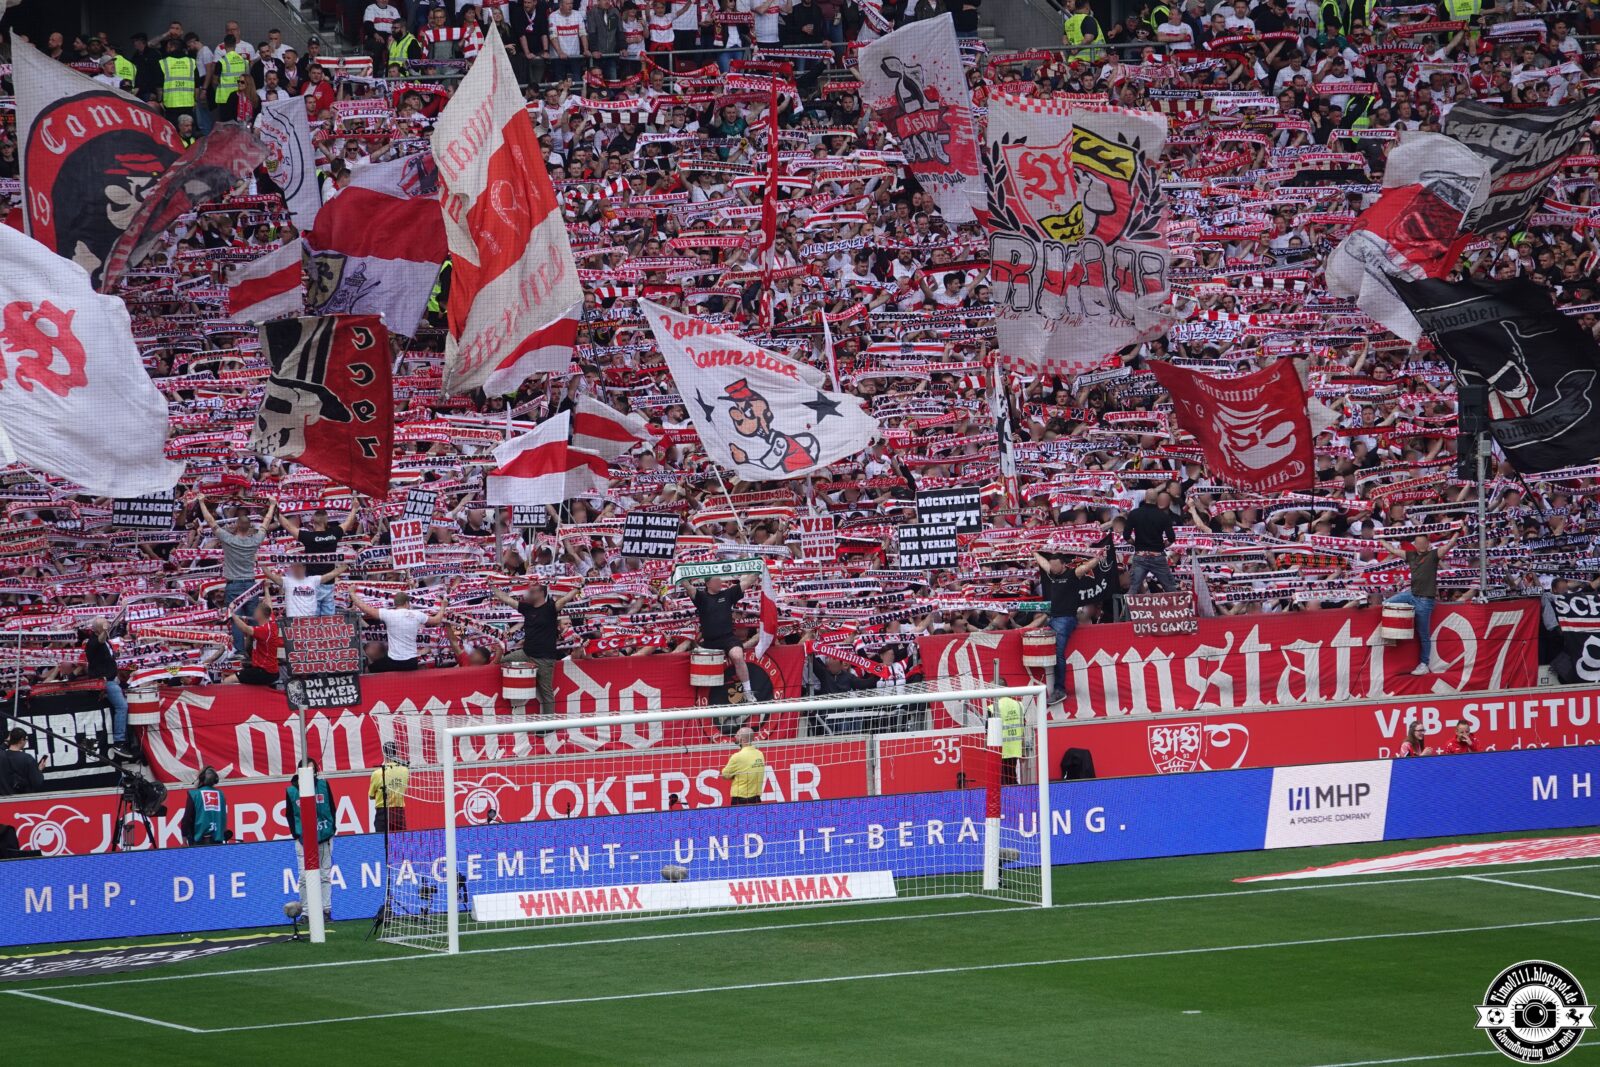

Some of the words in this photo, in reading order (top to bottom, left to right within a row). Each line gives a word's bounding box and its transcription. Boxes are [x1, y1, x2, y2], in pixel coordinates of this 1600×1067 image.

[581, 98, 639, 109] STUTTGART
[409, 490, 437, 502] VOGT
[918, 494, 980, 507] RÜCKTRITT
[114, 501, 128, 512] DU
[130, 501, 173, 512] FALSCHE
[405, 501, 434, 513] UND
[513, 505, 546, 513] ADRION
[112, 514, 172, 526] SCHLANGE
[513, 513, 546, 524] RAUS
[627, 515, 646, 526] IHR
[649, 515, 678, 527] MACHT
[802, 517, 834, 532] VfB
[391, 521, 422, 539] VfB
[624, 529, 642, 539] DEN
[644, 530, 676, 540] VEREIN
[900, 528, 917, 538] IHR
[920, 526, 955, 537] MACHT
[1383, 522, 1450, 535] COMMANDO
[392, 536, 423, 545] STUTTGART
[900, 541, 918, 551] DEN
[922, 539, 956, 549] VEREIN
[408, 543, 424, 552] SIND
[622, 542, 675, 556] KAPUTT
[803, 546, 836, 558] WIR
[270, 553, 345, 563] COMMANDO
[393, 551, 425, 566] WIR
[900, 552, 957, 567] KAPUTT
[680, 565, 719, 577] MAGIC
[734, 560, 763, 573] FANS
[1370, 573, 1389, 583] CC
[826, 593, 904, 608] COMMANDO
[1126, 594, 1168, 607] ULTRA
[1226, 589, 1296, 601] COMMANDO
[291, 615, 345, 627] JEDER
[868, 604, 933, 625] COMMANDO
[1130, 610, 1153, 620] DER
[284, 624, 354, 640] VERBANNTE
[1133, 623, 1158, 633] UMS
[1160, 620, 1199, 633] GANZE
[293, 638, 350, 649] KEHRT
[597, 638, 620, 649] CC
[641, 635, 661, 644] 97
[287, 647, 360, 663] STÄRKER
[812, 640, 872, 669] Commando
[1429, 609, 1524, 694] 97
[291, 661, 360, 674] ZURÜCK
[305, 678, 323, 689] DU
[328, 675, 354, 685] BIST
[306, 684, 357, 698] IMMER
[309, 697, 327, 707] BEI
[332, 694, 359, 706] UNS!
[1375, 696, 1600, 738] VfB-STIFTU
[1151, 725, 1200, 755] VfB
[933, 738, 961, 765] 35
[520, 763, 821, 821] JOKERSAR
[1315, 782, 1370, 808] MHP
[1290, 817, 1296, 825] A
[1297, 815, 1333, 825] PORSCHE
[1335, 811, 1371, 822] COMPANY
[25, 881, 136, 914] MHP.
[173, 871, 246, 903] DIE
[674, 833, 764, 865] UND
[799, 806, 1128, 855] IT-BERAUNG.
[728, 875, 853, 905] WINAMAX
[519, 886, 644, 917] WINAMAX
